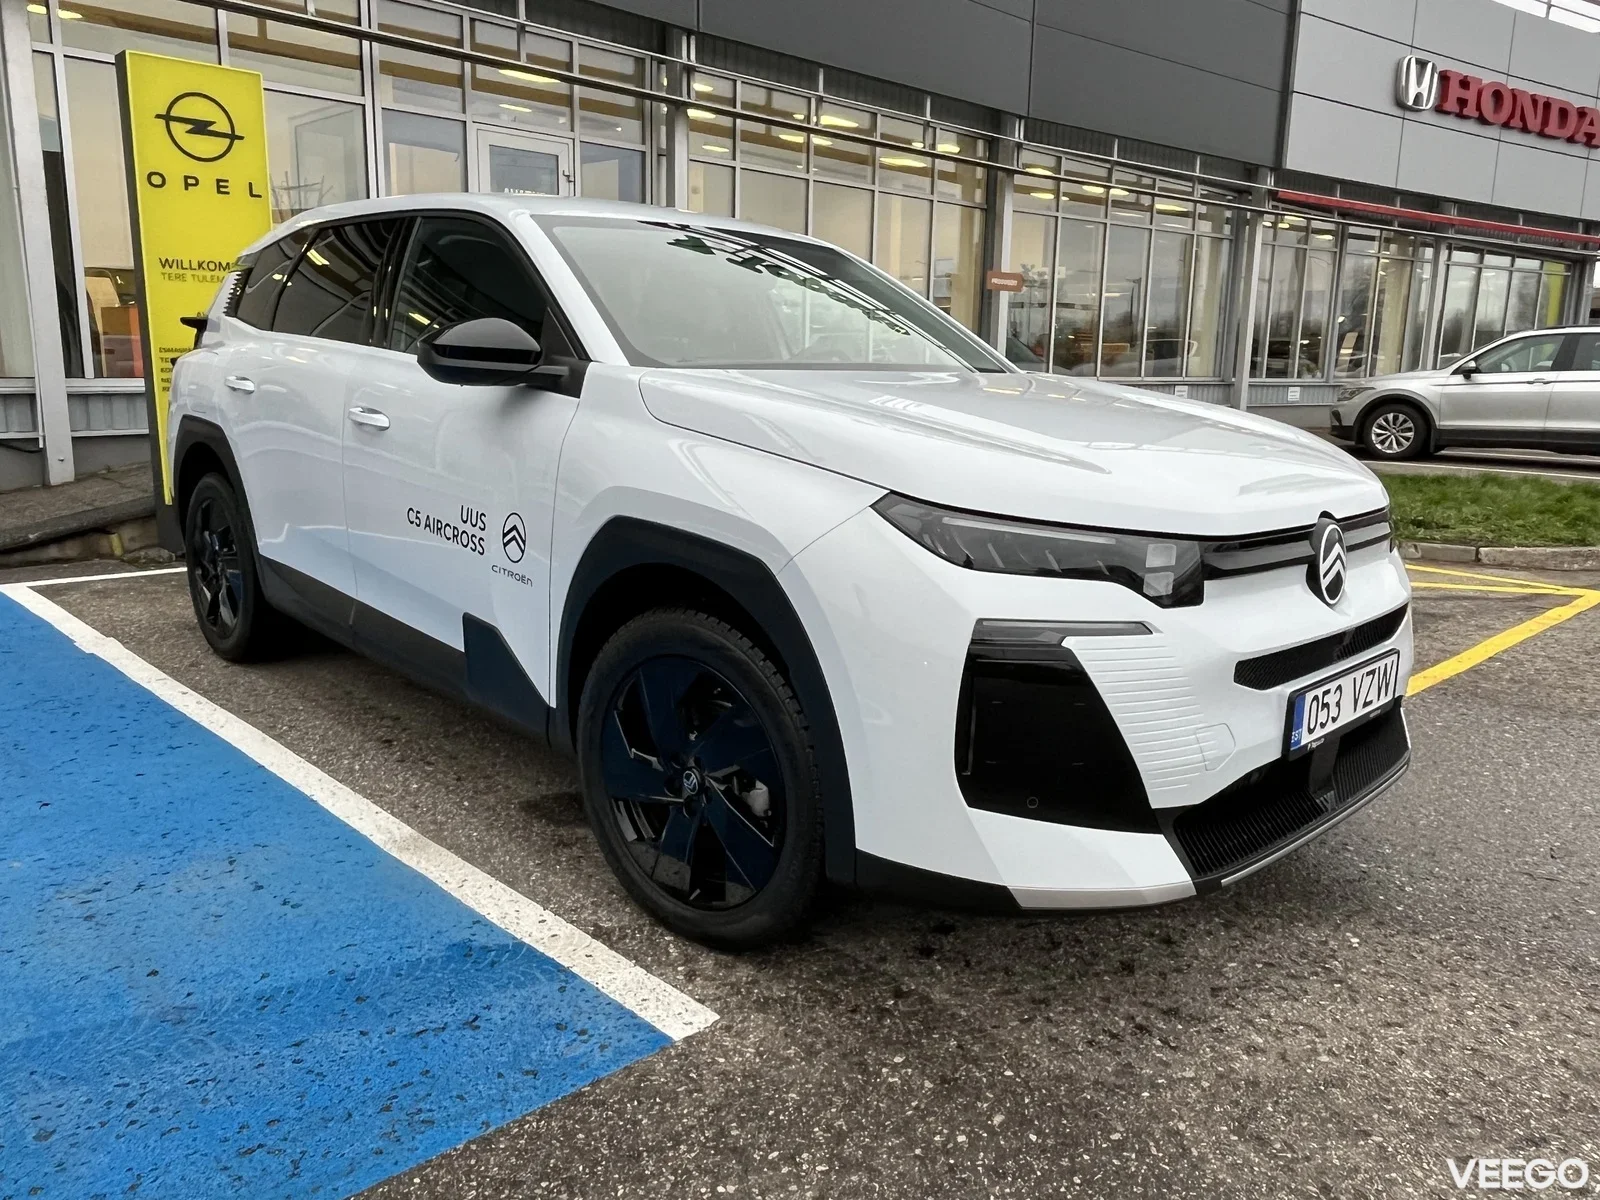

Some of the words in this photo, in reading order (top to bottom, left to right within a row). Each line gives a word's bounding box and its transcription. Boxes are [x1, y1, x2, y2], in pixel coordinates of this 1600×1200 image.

[1435, 69, 1600, 148] HONDA
[146, 171, 262, 198] OPEL
[158, 257, 235, 272] WILLKOM
[161, 272, 187, 283] TERE
[406, 507, 421, 528] C5
[423, 514, 485, 556] AIRCROSS
[460, 504, 486, 532] UUS
[1307, 683, 1343, 735] 053
[1352, 659, 1395, 714] VZW
[1291, 728, 1303, 743] EST
